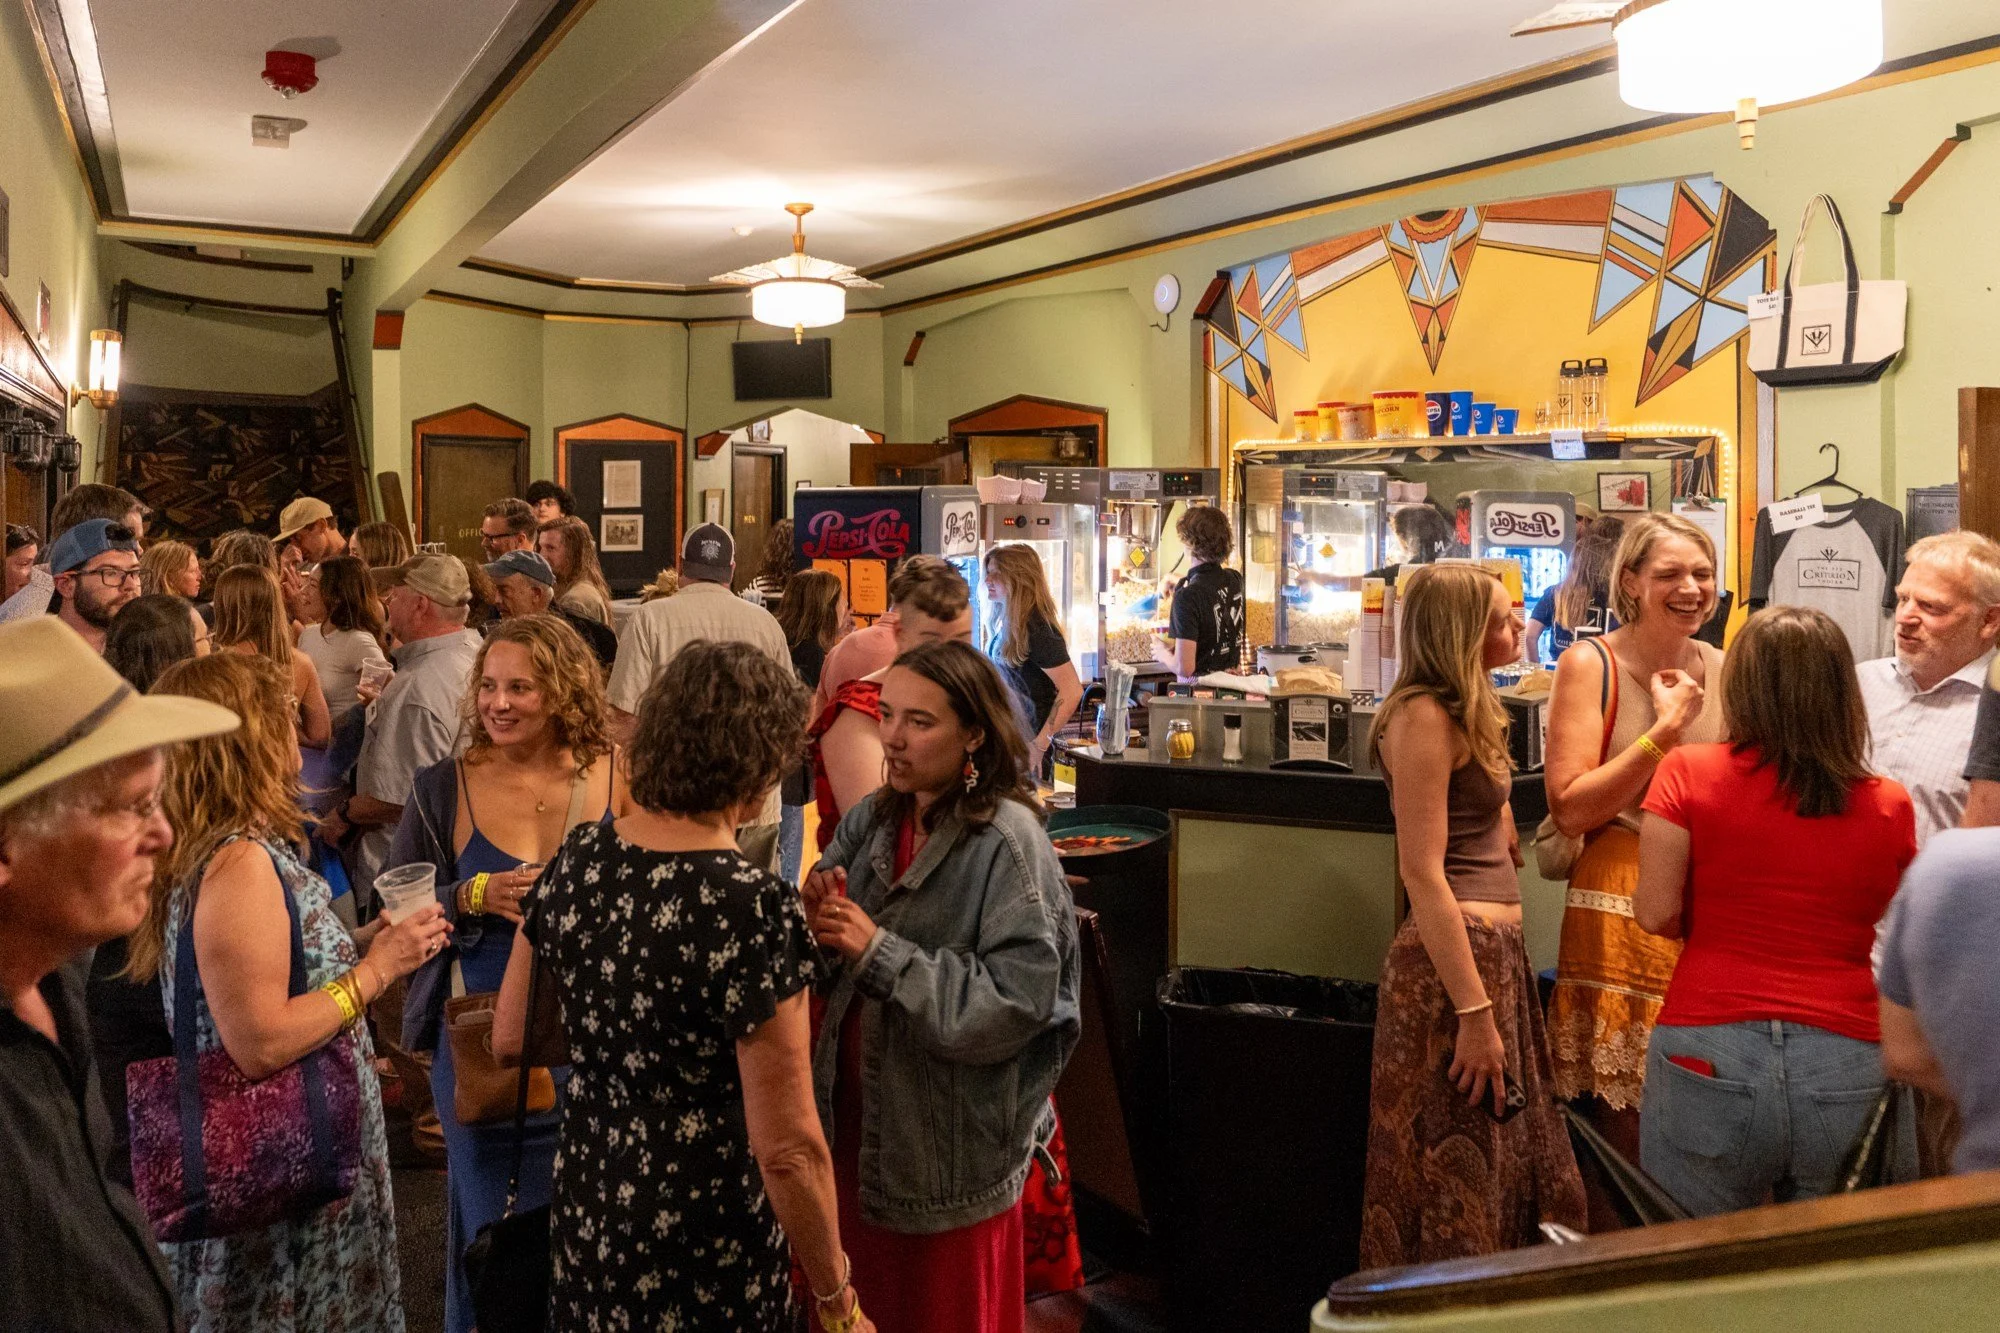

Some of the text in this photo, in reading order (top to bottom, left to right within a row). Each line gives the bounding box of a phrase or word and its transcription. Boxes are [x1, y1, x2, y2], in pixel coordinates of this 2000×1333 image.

[1780, 507, 1806, 516] BASEBALL
[459, 528, 483, 537] OFFIC
[1803, 569, 1855, 581] CRITERION
